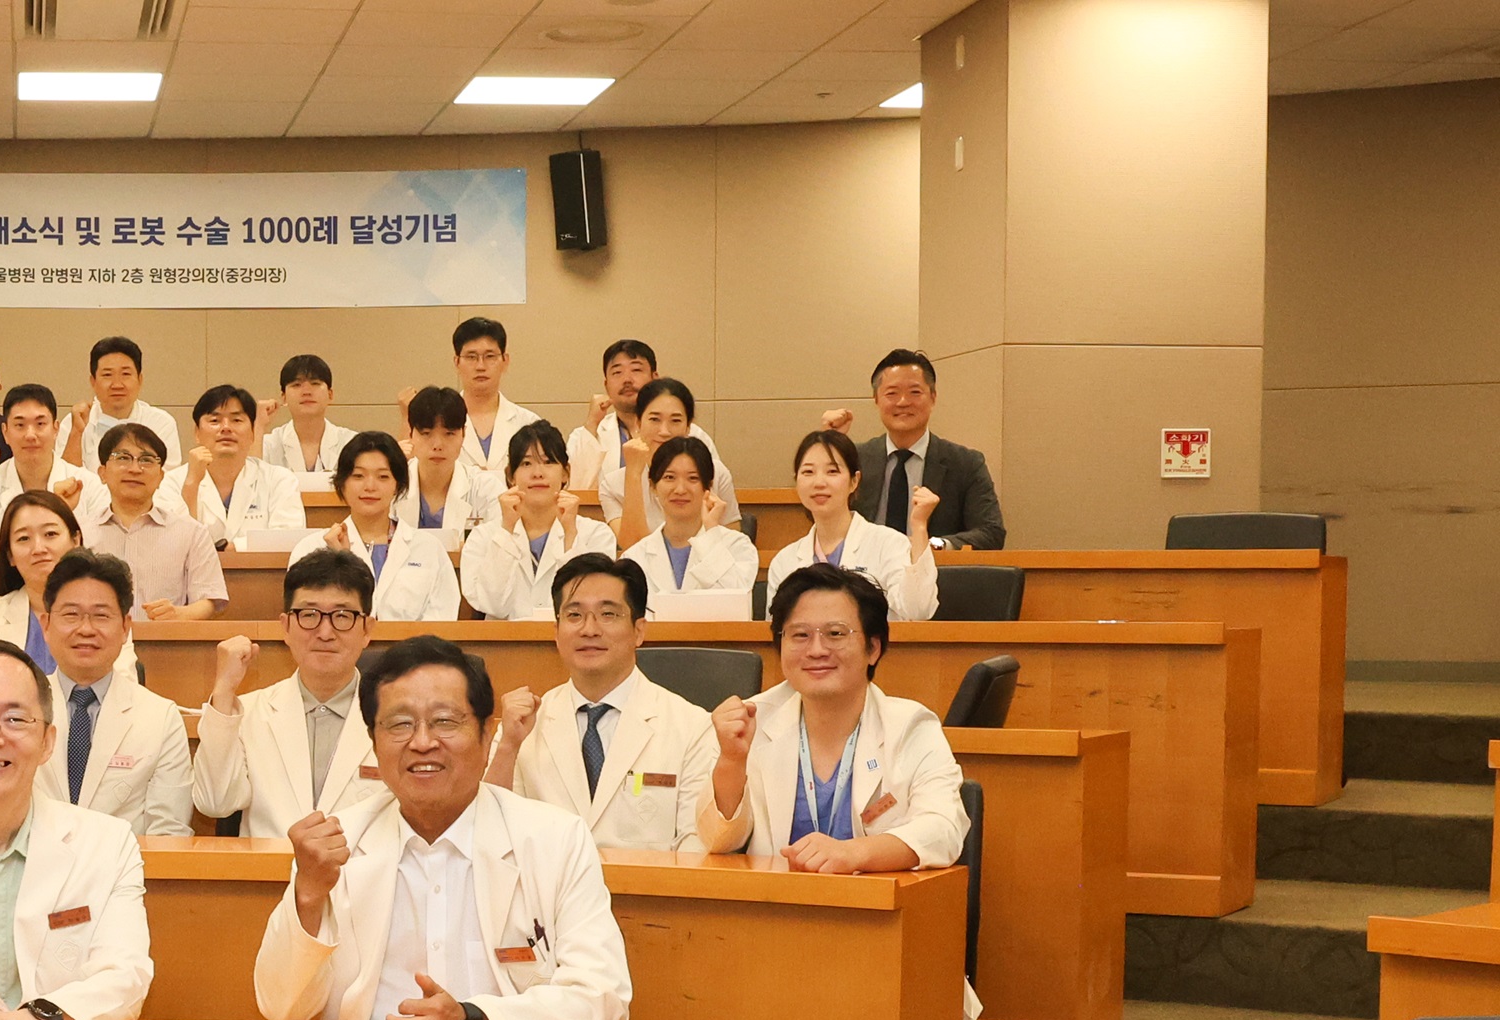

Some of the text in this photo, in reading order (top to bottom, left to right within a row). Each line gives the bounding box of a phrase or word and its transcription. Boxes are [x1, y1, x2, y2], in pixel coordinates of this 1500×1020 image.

[75, 216, 101, 247] 및
[111, 216, 166, 247] 로봇
[176, 216, 231, 247] 수술
[241, 215, 339, 246] 1000례
[349, 213, 458, 245] 달성기념
[40, 267, 83, 284] 암병원
[87, 267, 117, 284] 지하
[121, 267, 145, 285] 2층
[148, 266, 287, 285] 원형강의장(중강의장)
